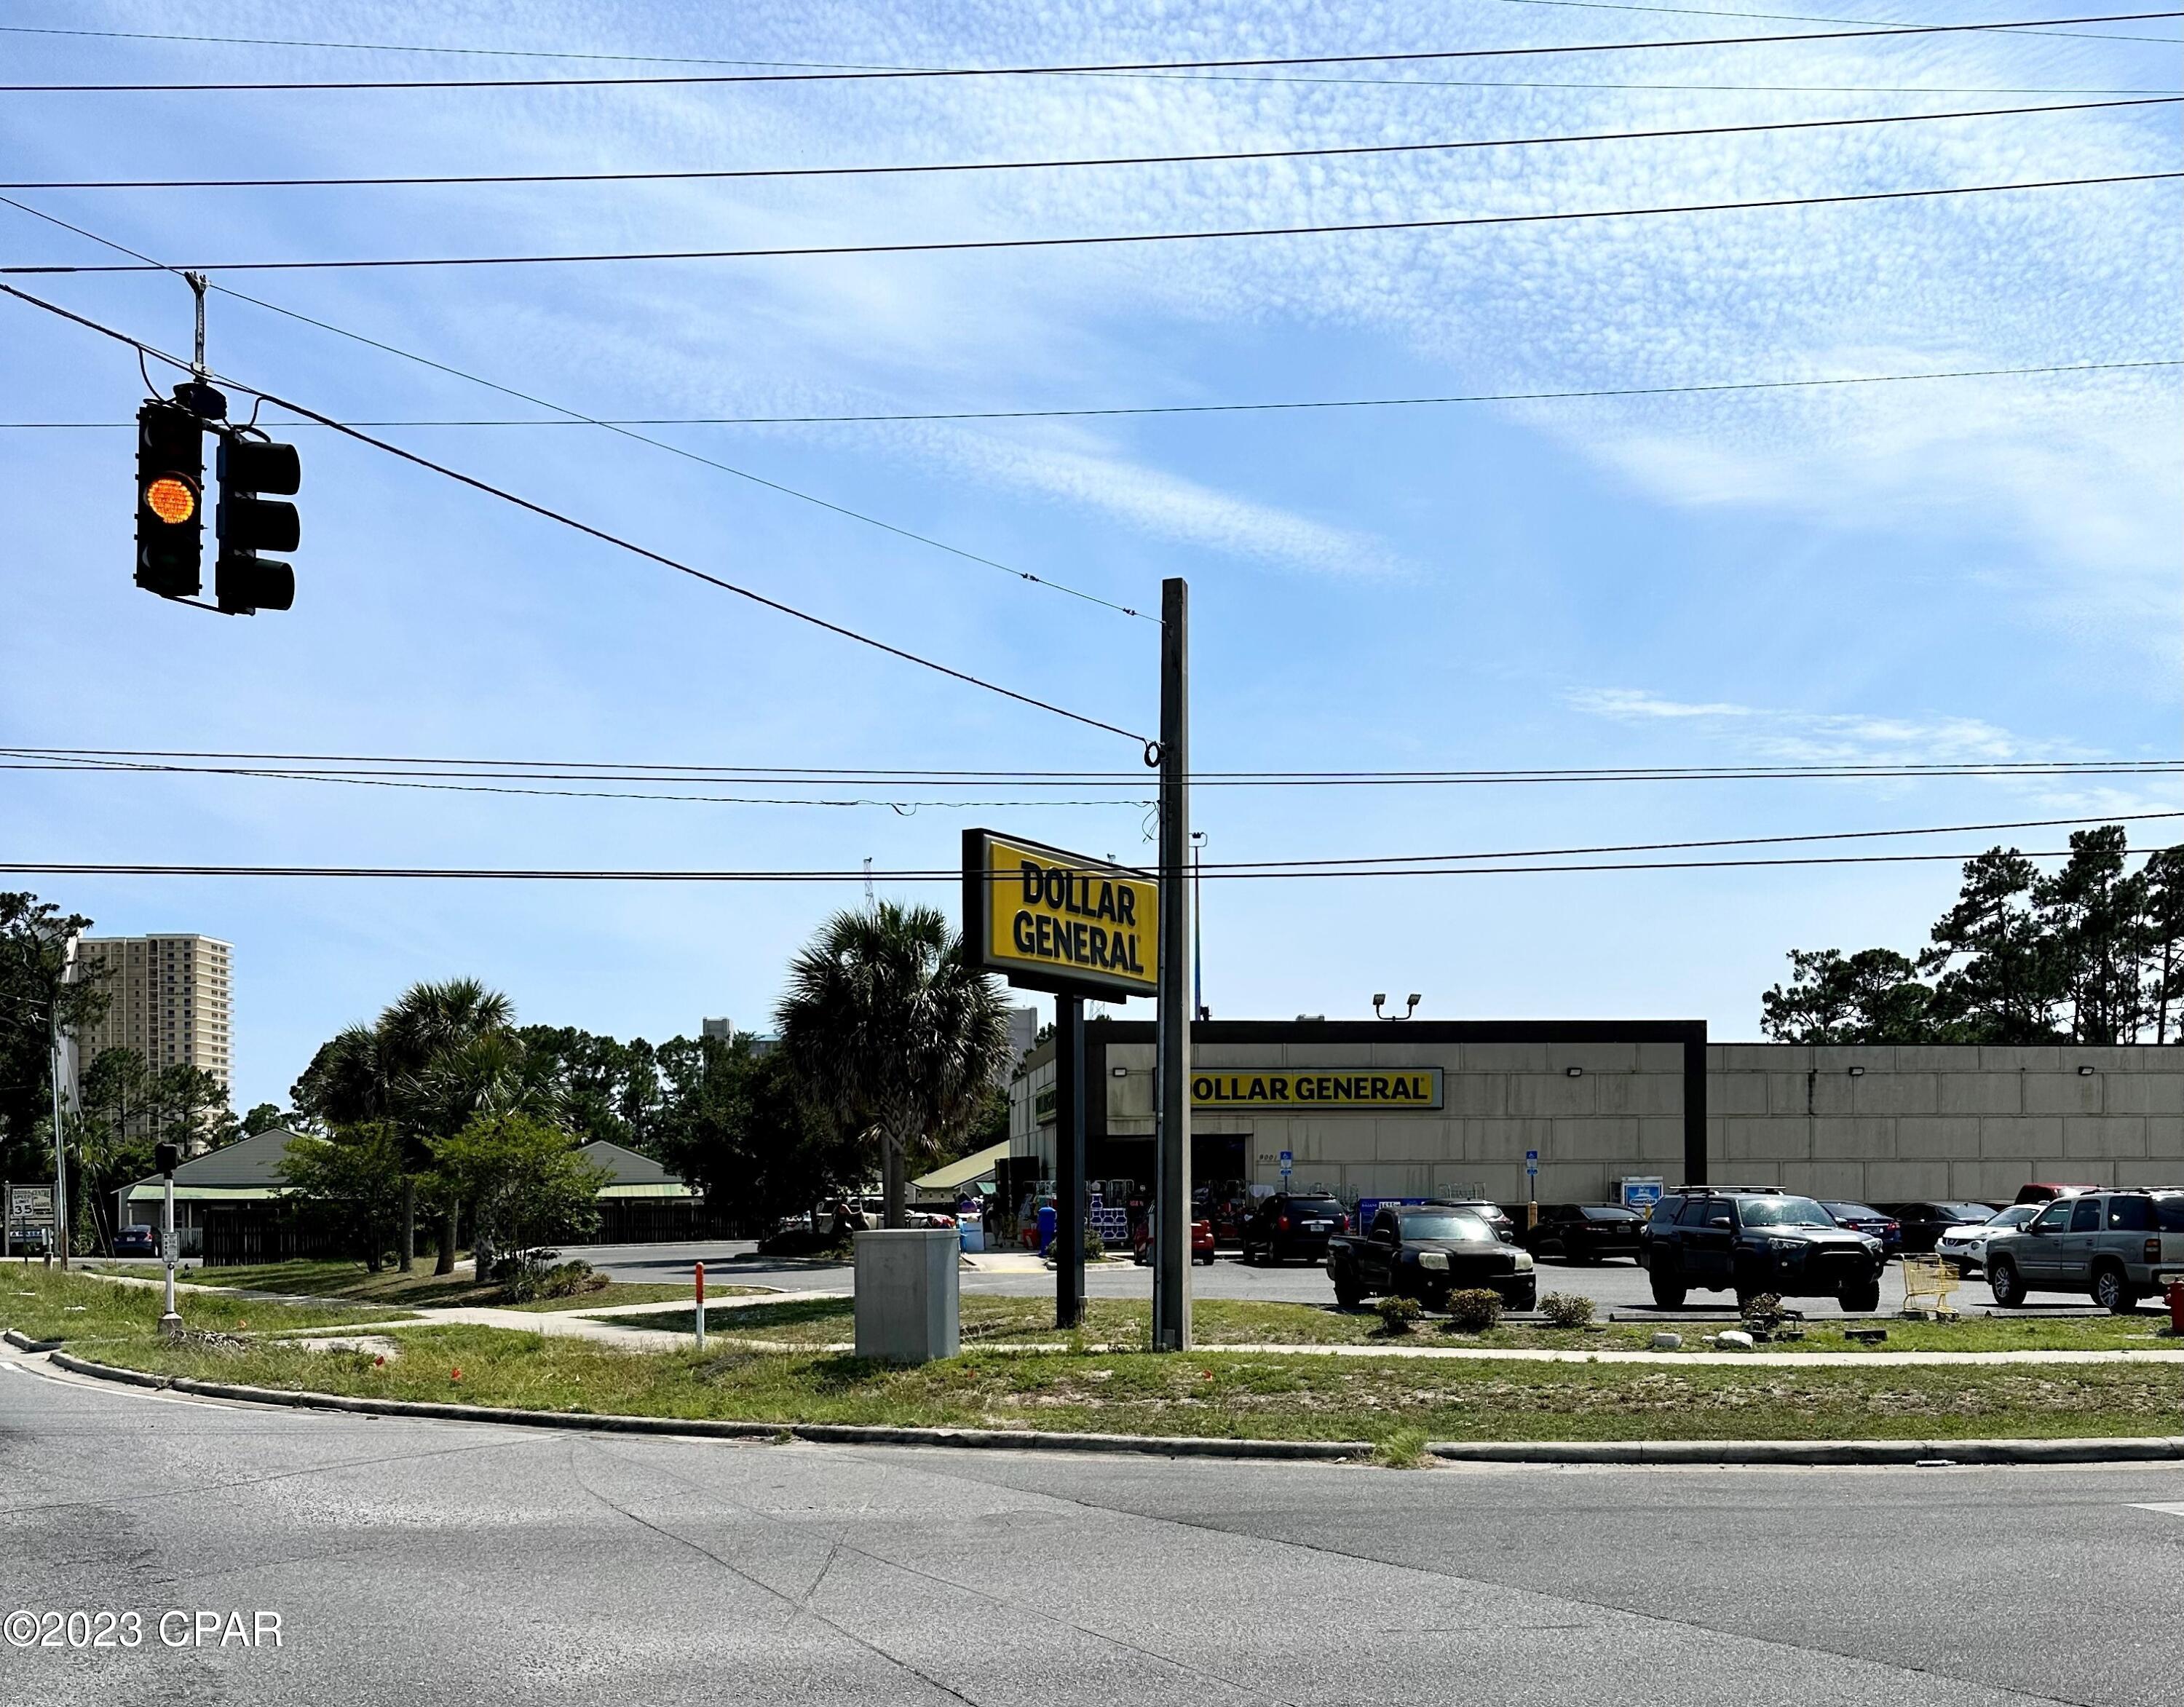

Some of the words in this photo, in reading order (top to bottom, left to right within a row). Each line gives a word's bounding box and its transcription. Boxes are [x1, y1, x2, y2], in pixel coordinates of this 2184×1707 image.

[1021, 859, 1136, 927] DOLLAR
[1013, 910, 1144, 974] GENERAL
[1190, 1077, 1289, 1100] OLLAR
[1294, 1077, 1428, 1100] GENERAL
[15, 1204, 32, 1215] 35
